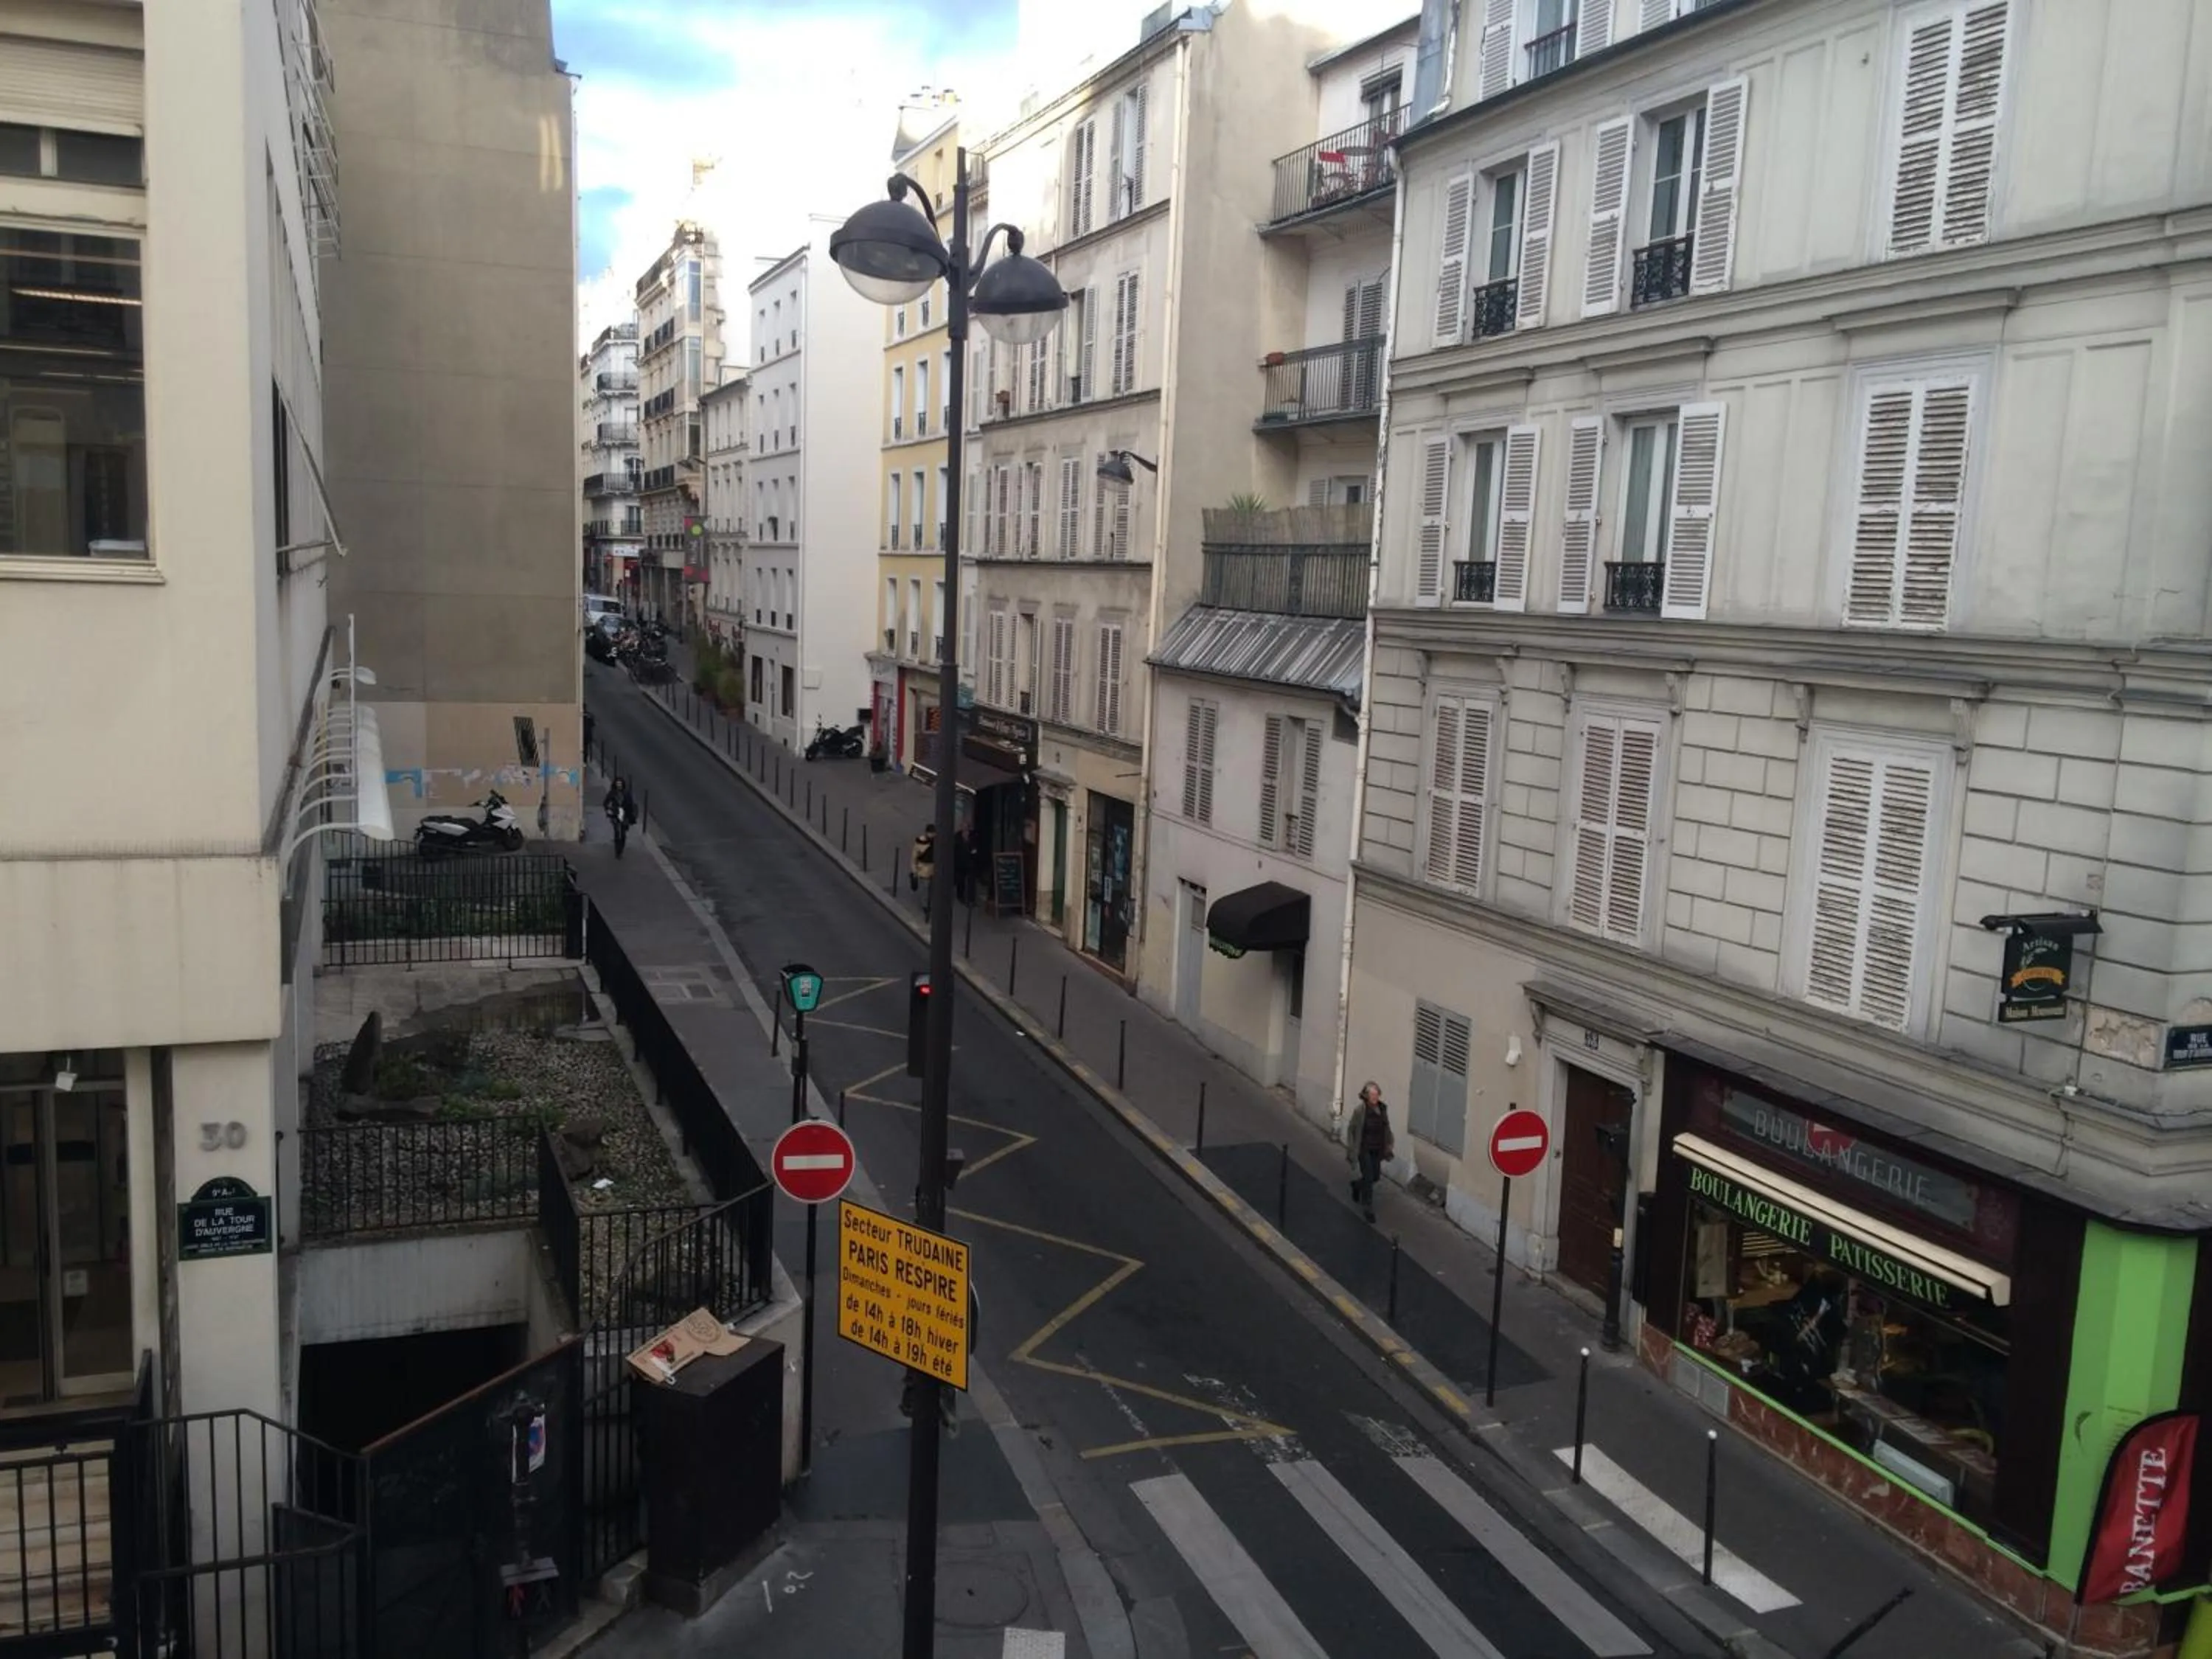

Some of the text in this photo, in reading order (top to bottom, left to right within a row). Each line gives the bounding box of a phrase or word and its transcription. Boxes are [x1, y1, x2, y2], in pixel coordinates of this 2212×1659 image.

[199, 1121, 247, 1152] 30
[1753, 1109, 1930, 1206] BOULANGERIE
[193, 1214, 255, 1228] DE LA TOUR
[195, 1224, 254, 1237] D'AUVERGNE
[215, 1207, 234, 1217] RUE
[844, 1208, 963, 1273] Secteur TRUDAINE
[1690, 1167, 1948, 1307] BOULANGERIE PATISSERIE
[843, 1266, 891, 1298] Dimanches
[906, 1295, 931, 1315] jours
[936, 1304, 964, 1329] fériés
[849, 1239, 956, 1303] PARIS RESPIRE
[846, 1293, 959, 1354] de 14h à 18h hiver
[851, 1318, 952, 1377] de 14h à 19h été
[2119, 1447, 2167, 1594] BANETTE
